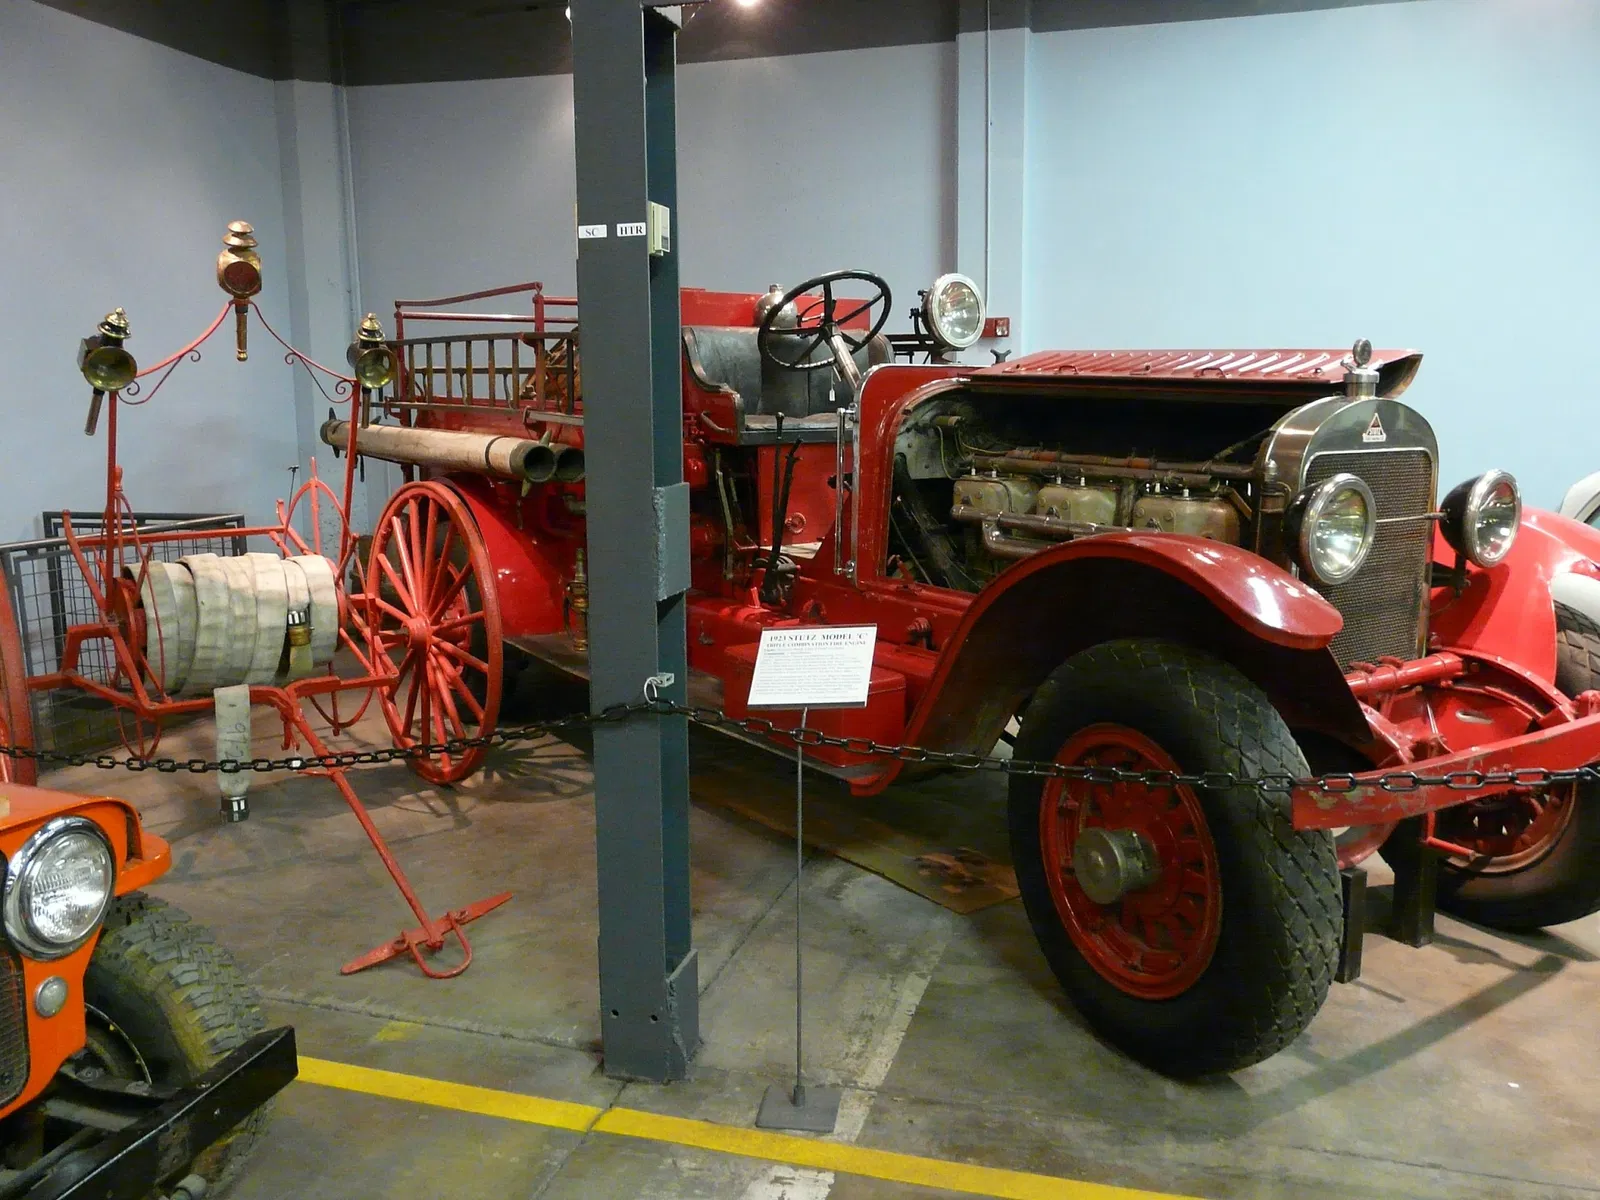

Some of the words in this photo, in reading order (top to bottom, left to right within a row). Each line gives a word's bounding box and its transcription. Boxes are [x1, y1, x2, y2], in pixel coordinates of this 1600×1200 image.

[585, 228, 599, 237] SC
[620, 225, 643, 235] HTR
[821, 633, 853, 641] MODEL
